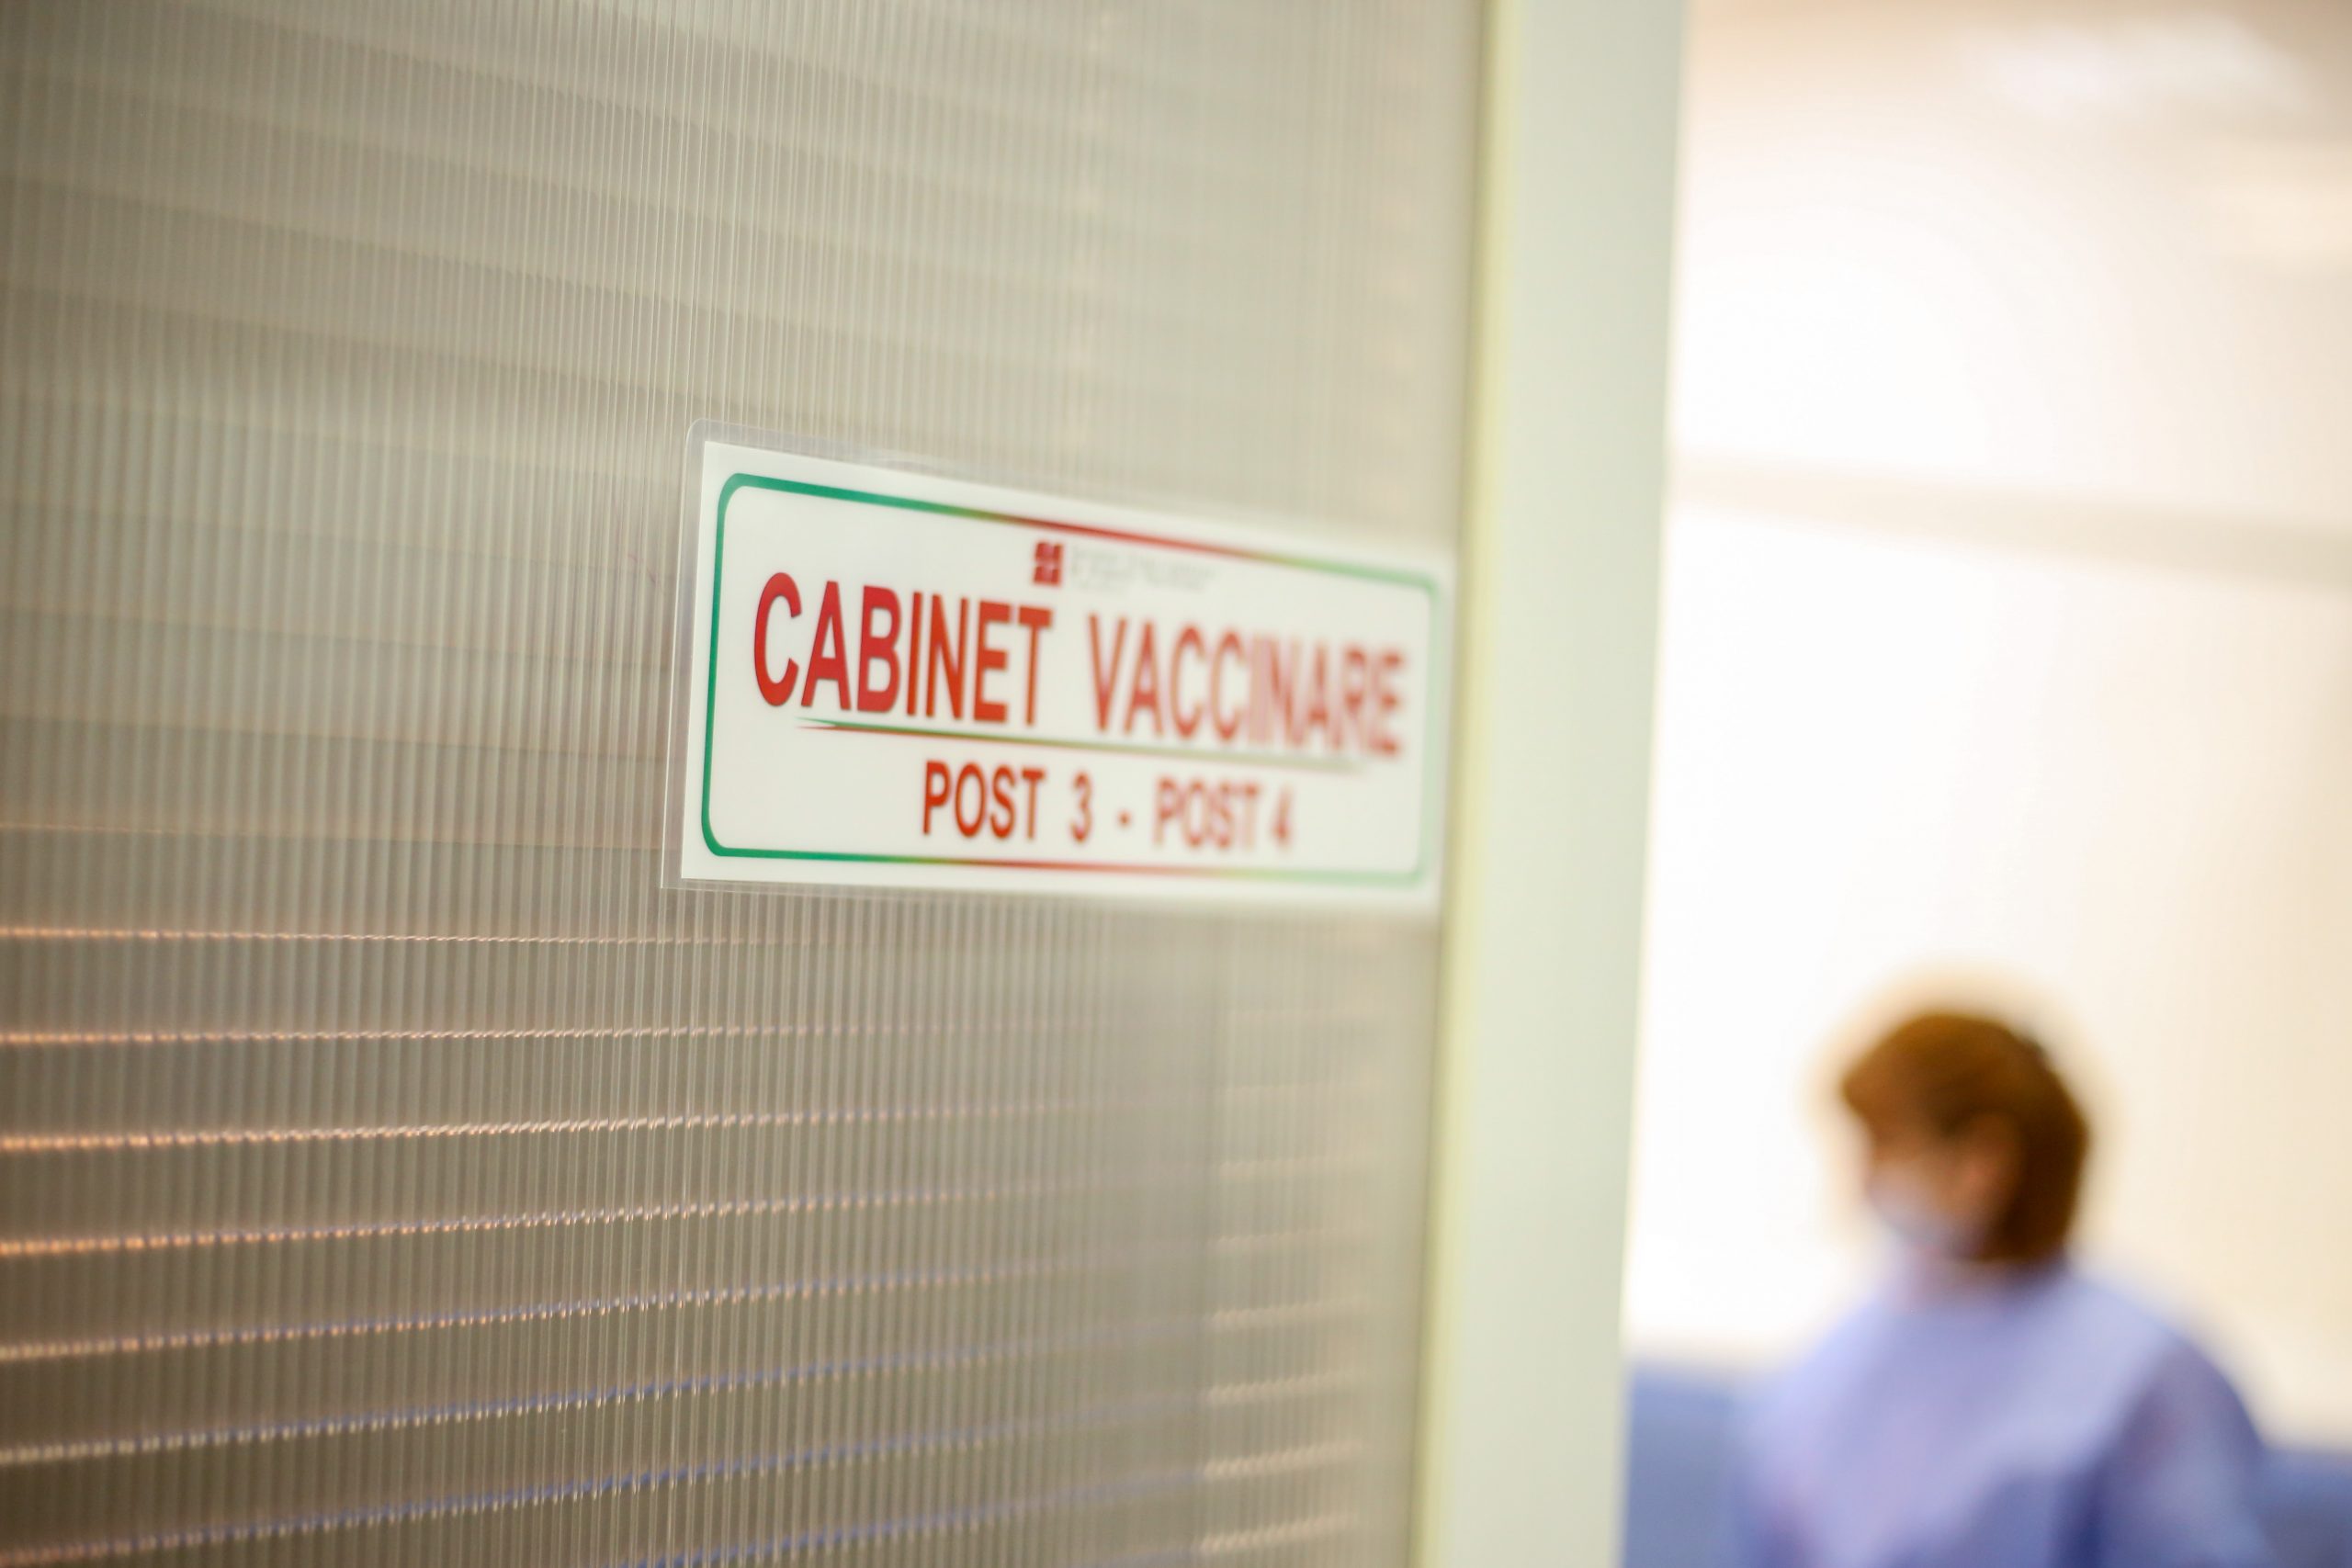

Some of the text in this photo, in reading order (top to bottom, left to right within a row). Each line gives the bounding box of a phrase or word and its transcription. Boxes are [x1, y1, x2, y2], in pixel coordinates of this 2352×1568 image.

[753, 571, 1408, 757] CABINET VACCINARE
[922, 759, 1046, 840] POST
[1069, 773, 1092, 842] 3
[1156, 778, 1262, 850] POST
[1267, 787, 1294, 849] 4
